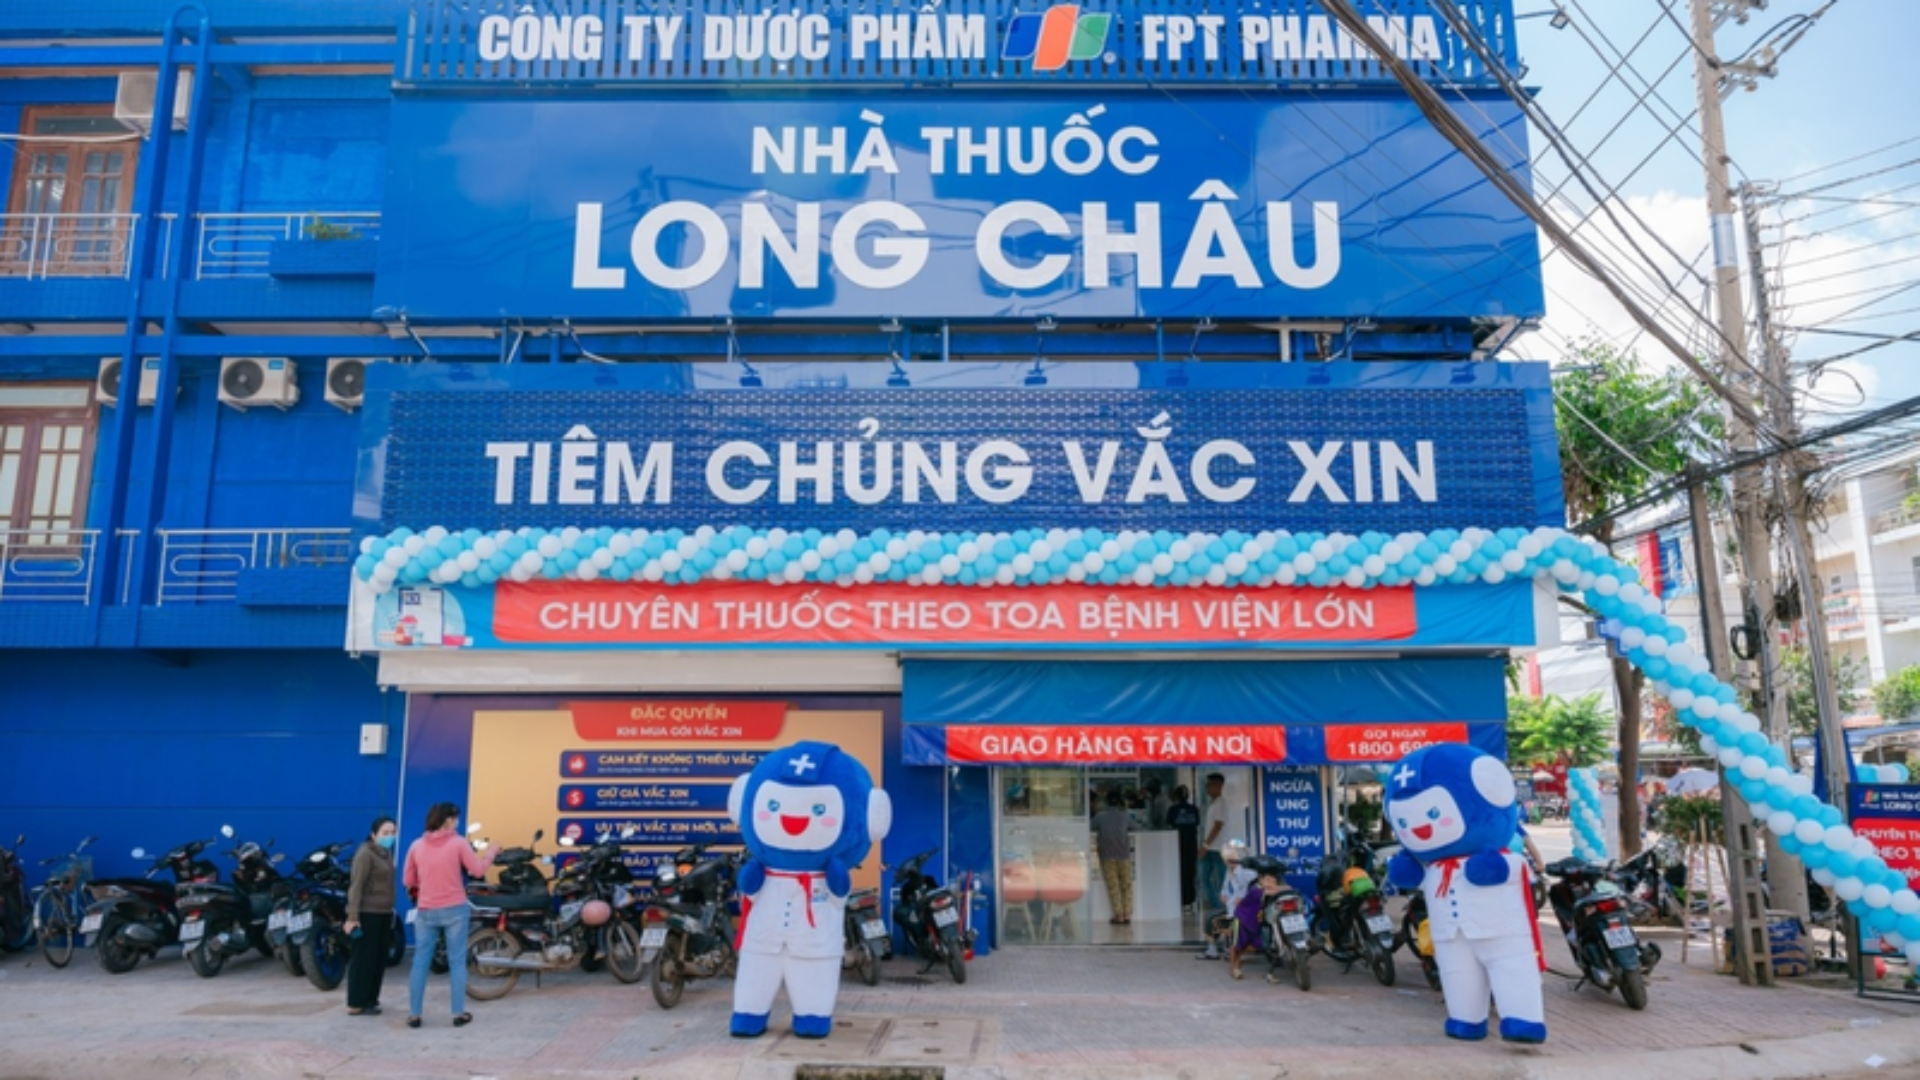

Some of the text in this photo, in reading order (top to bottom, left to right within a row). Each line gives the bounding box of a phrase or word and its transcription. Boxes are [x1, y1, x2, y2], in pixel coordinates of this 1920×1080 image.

[478, 5, 602, 61] CÔNG
[623, 16, 683, 60] TY
[703, 8, 830, 71] DƯỢC
[850, 0, 986, 60] PHẨM
[1142, 15, 1225, 61] FPT
[751, 104, 1160, 175] NHÀ THUỐC
[571, 178, 1342, 289] LONG CHÂU
[485, 410, 1438, 506] TIÊM CHỦNG VẮC XIN
[539, 590, 1376, 640] CHUYÊN THUỐC THEO TOA BỆNH VIỆN LỚN
[630, 704, 665, 723] ĐẶC
[616, 723, 743, 737] KHI MUA GÓI VẮC XIN
[1363, 728, 1428, 740] GỌI NGAY
[981, 731, 1252, 759] GIAO HÀNG TẬN NƠI
[1347, 741, 1443, 755] 1800 69
[598, 754, 624, 764] CAM
[652, 752, 693, 764] KHÔNG
[669, 789, 689, 798] XIN
[1276, 799, 1309, 810] UNG
[670, 822, 689, 832] XIN
[1278, 816, 1310, 829] THƯ
[1267, 836, 1321, 847] DO HPV
